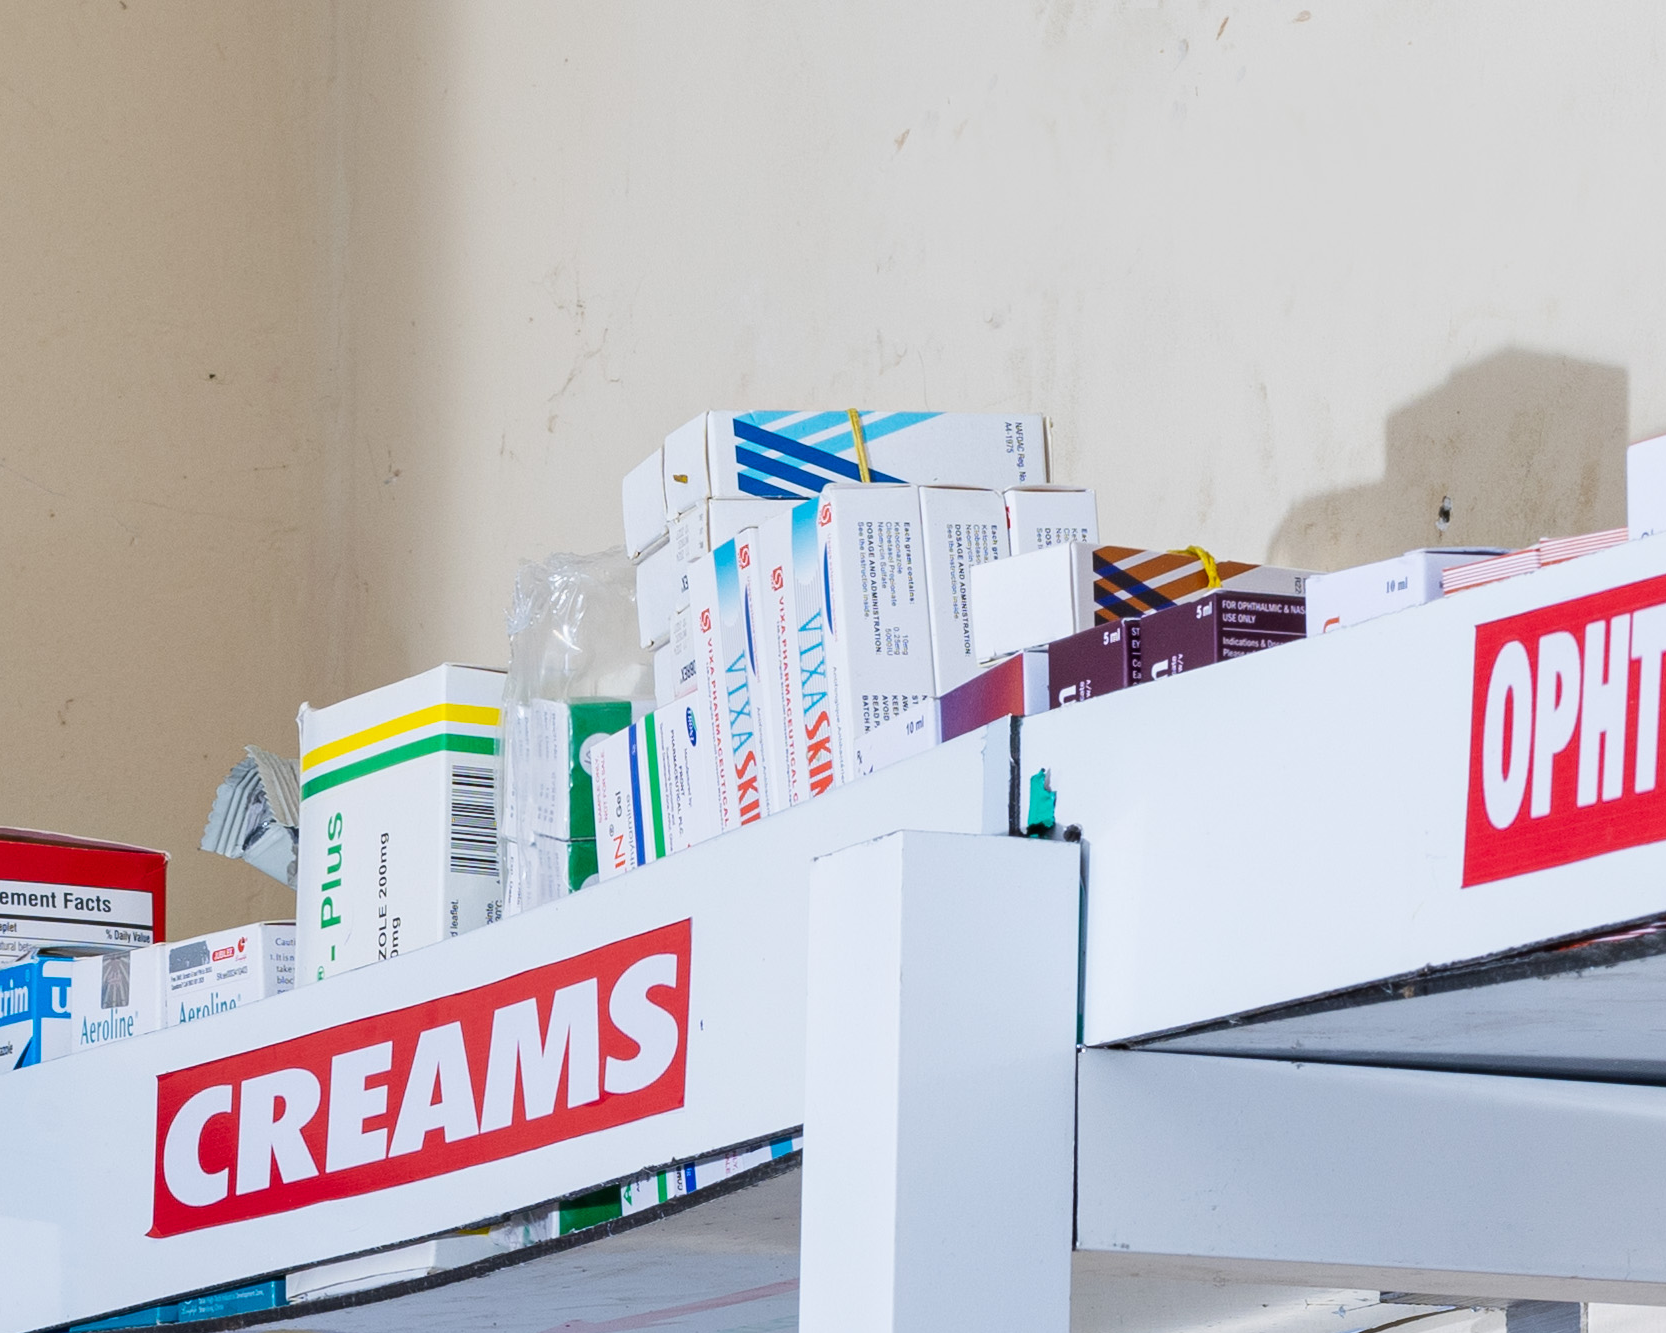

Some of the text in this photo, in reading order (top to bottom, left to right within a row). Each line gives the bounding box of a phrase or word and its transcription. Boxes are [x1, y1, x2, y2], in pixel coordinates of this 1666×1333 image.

[1005, 421, 1014, 454] A4-1975
[1015, 422, 1024, 451] NAFDAC
[865, 521, 882, 655] DOSAGE AND ADMINISTRATION:
[63, 889, 112, 915] Facts
[320, 810, 344, 930] Plus
[163, 953, 679, 1208] CREAMS
